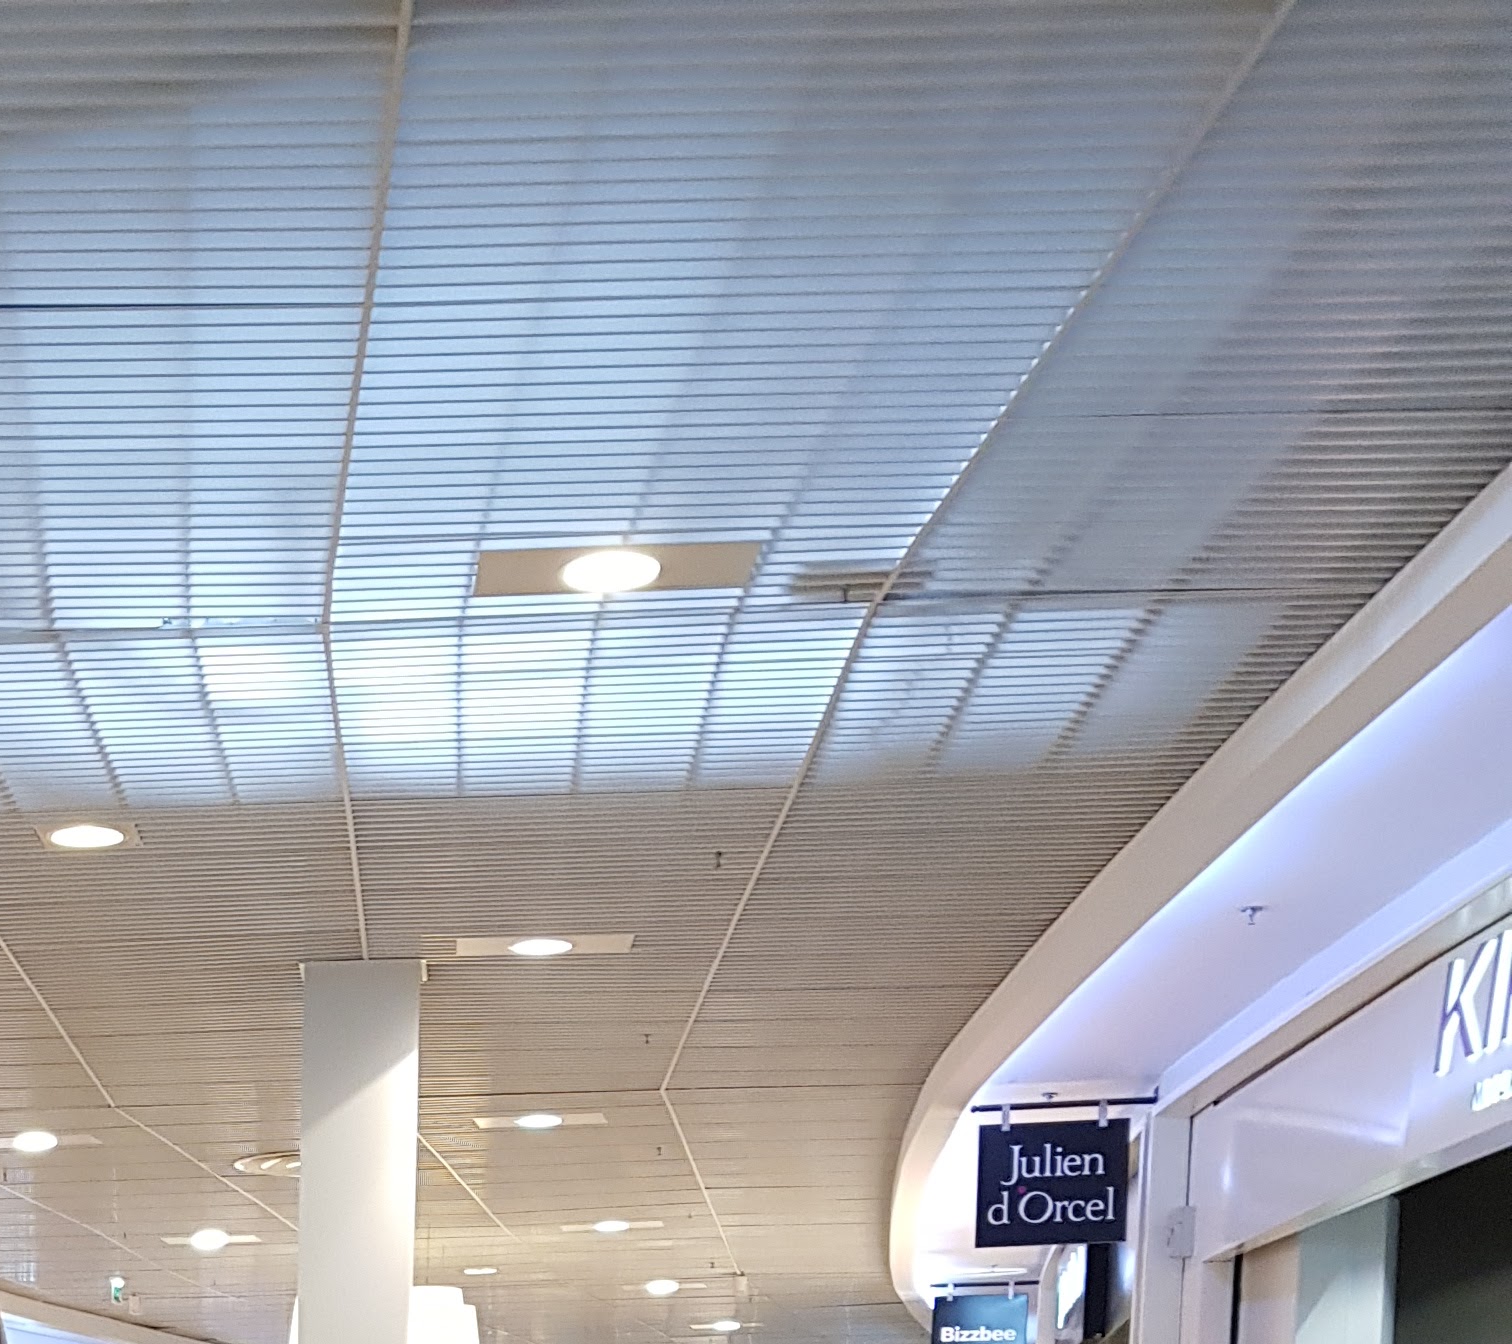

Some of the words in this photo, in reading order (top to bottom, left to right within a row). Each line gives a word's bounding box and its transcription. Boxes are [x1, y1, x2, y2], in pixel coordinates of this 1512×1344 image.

[1435, 930, 1512, 1078] KI
[999, 1143, 1106, 1186] Julien
[940, 1325, 1018, 1343] Bizzbee
